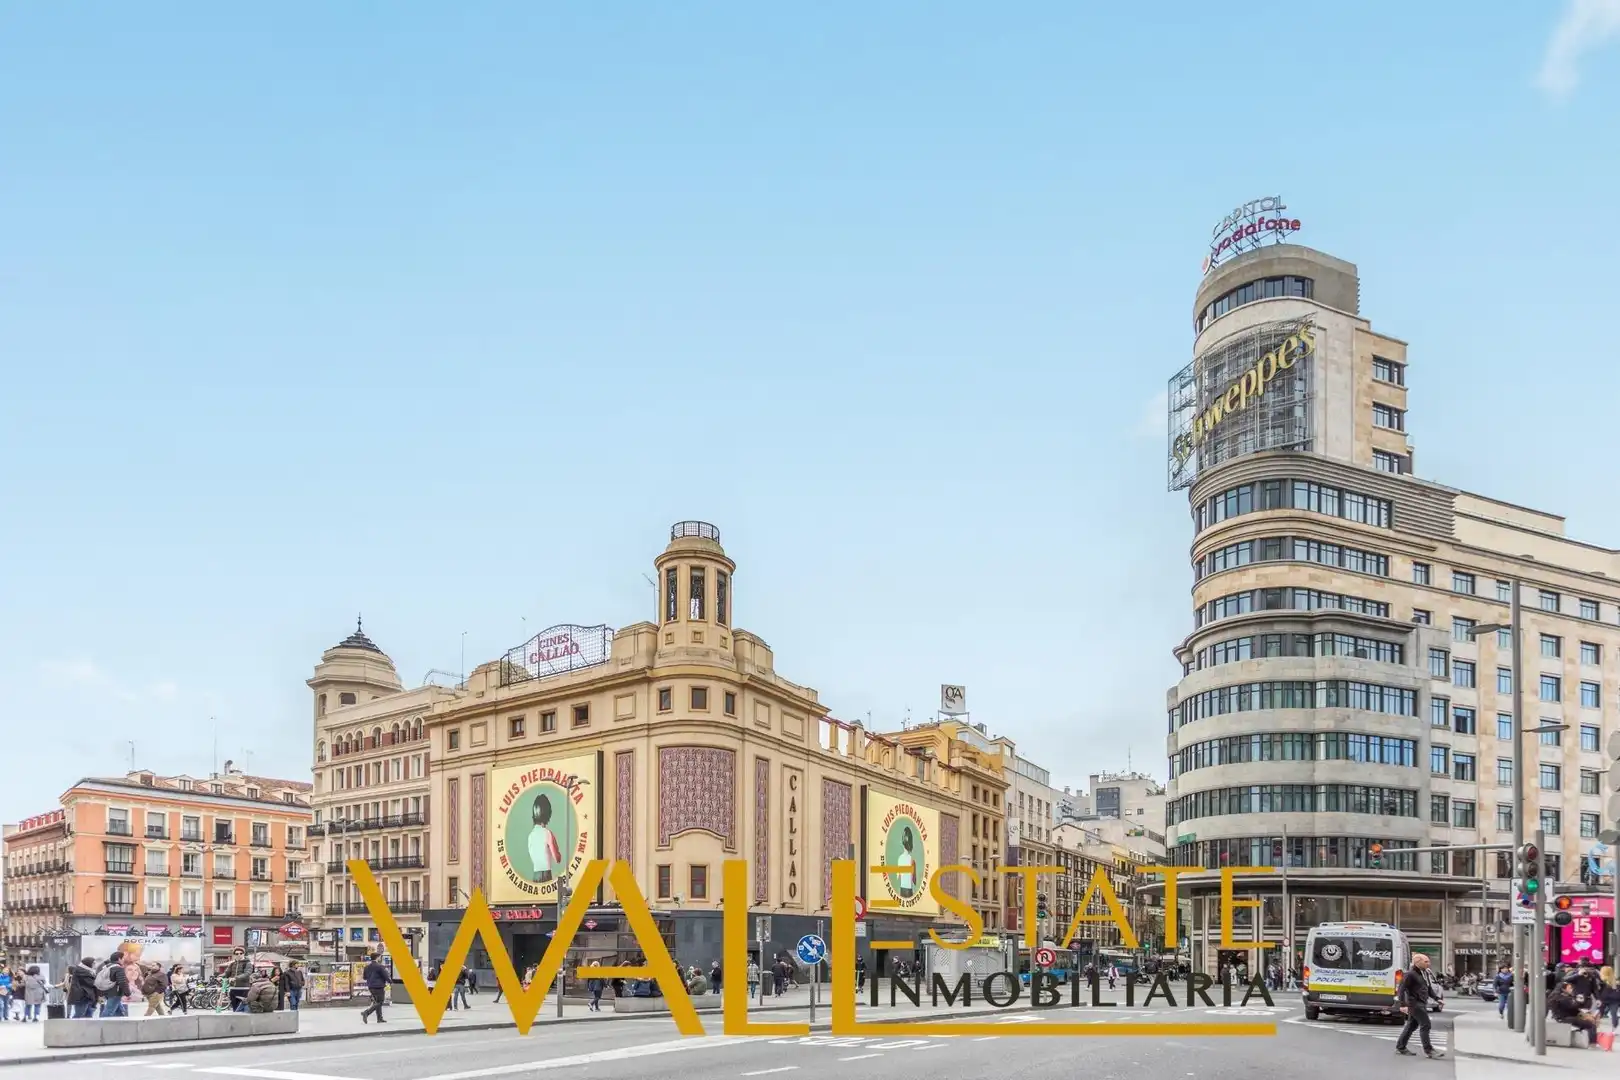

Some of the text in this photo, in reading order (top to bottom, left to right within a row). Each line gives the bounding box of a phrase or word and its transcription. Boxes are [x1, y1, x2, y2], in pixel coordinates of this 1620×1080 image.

[1213, 216, 1301, 257] vodafone
[539, 633, 569, 649] CINES
[530, 642, 580, 664] CALLAO
[498, 768, 584, 815] LUIS PIEDRAHTA
[881, 803, 928, 841] LUIS PIEDRAHITA
[497, 839, 505, 853] ES
[789, 775, 797, 899] CALLAO
[500, 855, 509, 869] MI
[571, 856, 582, 871] LA
[506, 868, 539, 895] PALABRA
[1573, 918, 1592, 932] 15
